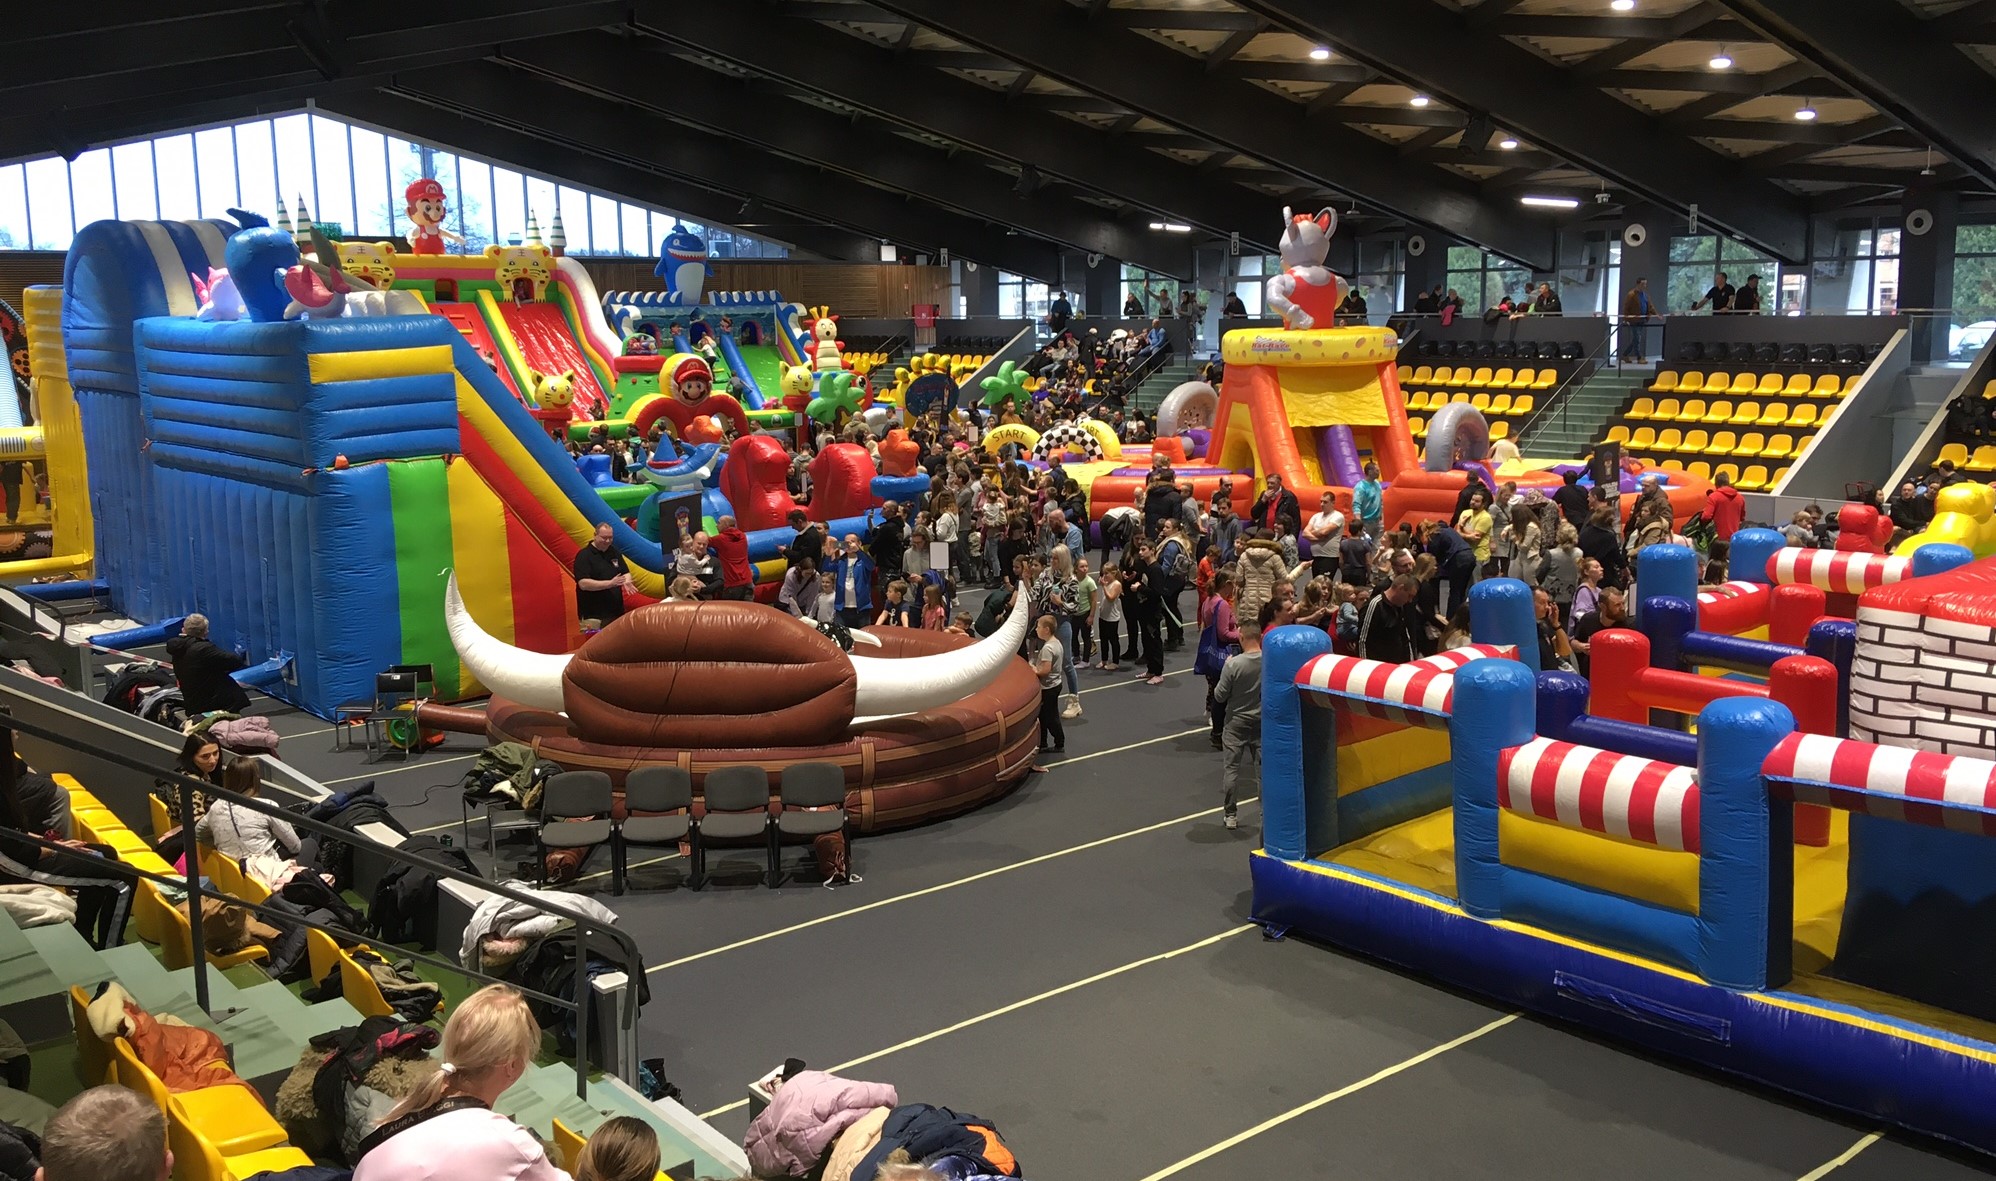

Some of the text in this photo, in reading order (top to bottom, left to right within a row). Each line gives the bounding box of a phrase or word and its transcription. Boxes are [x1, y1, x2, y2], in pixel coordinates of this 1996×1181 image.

[427, 185, 438, 193] M
[992, 429, 1027, 442] START
[1081, 424, 1100, 438] ART
[382, 1116, 415, 1137] LAURA
